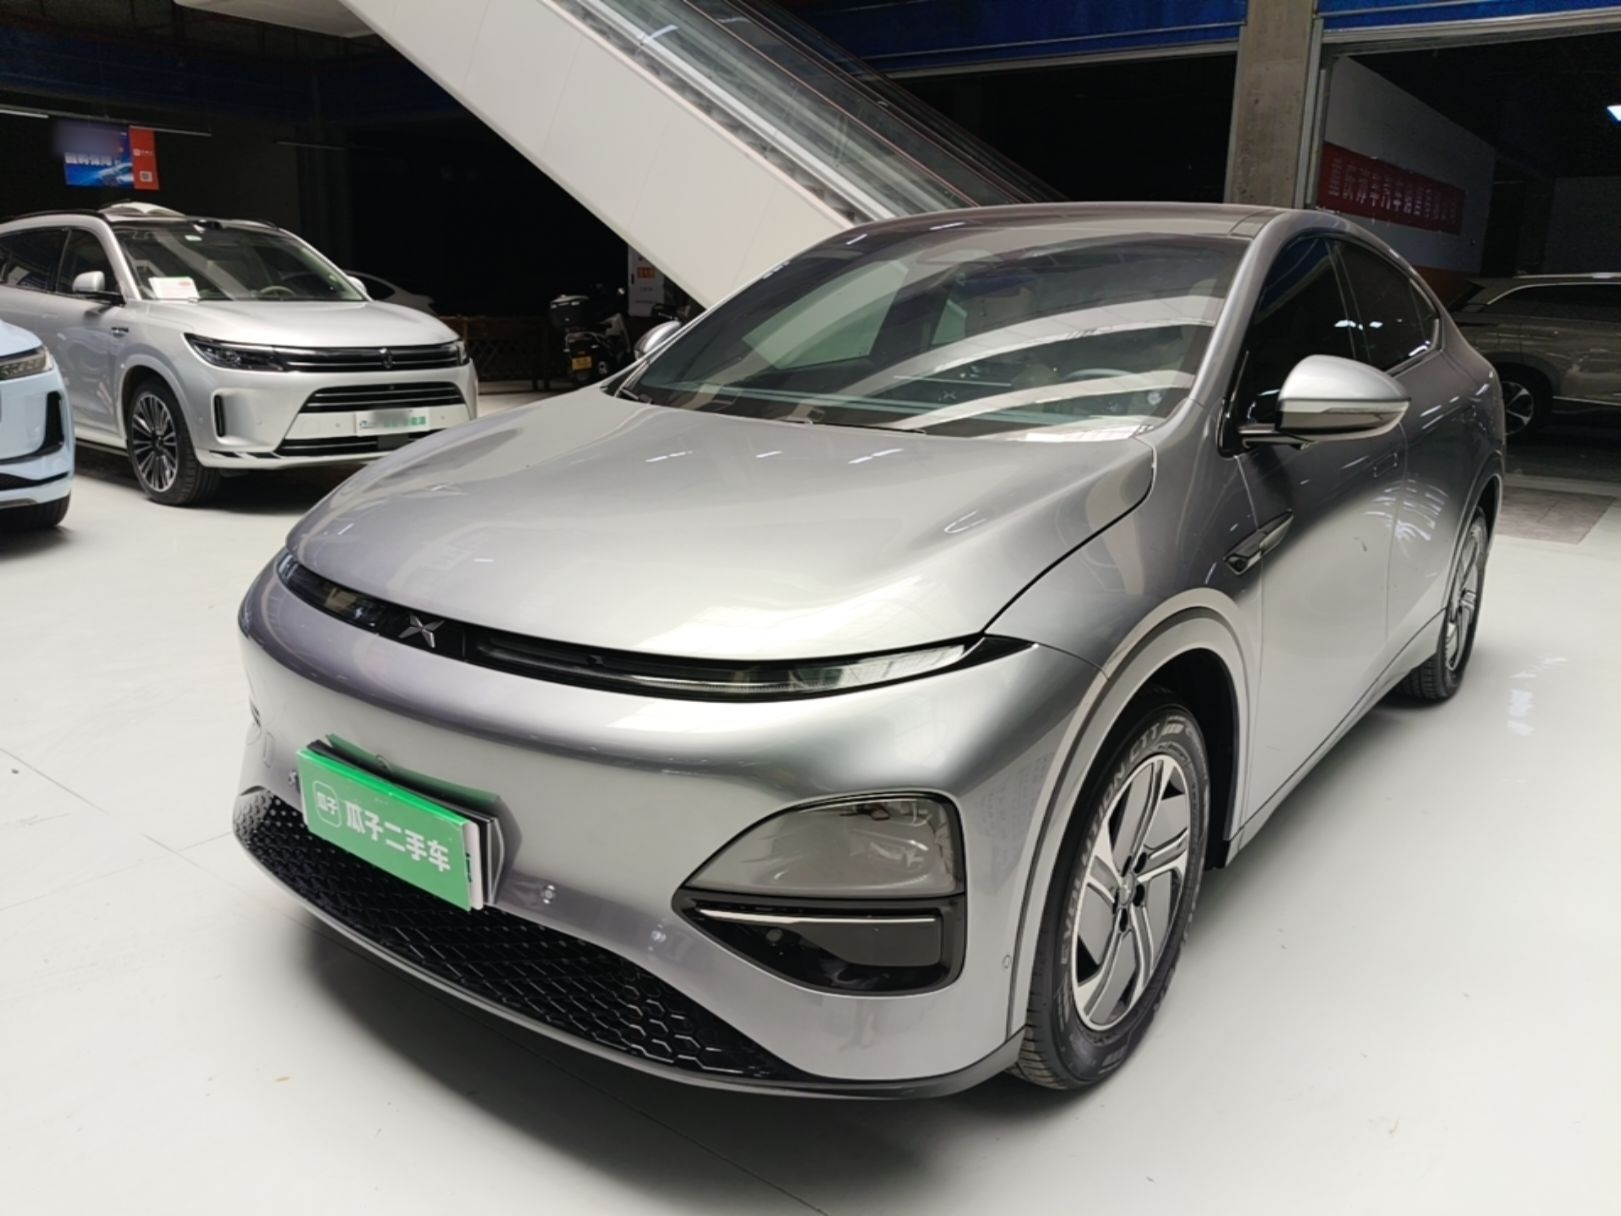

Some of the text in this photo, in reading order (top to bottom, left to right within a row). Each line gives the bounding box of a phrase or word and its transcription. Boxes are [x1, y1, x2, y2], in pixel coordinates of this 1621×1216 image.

[345, 801, 451, 872] 瓜子二手车
